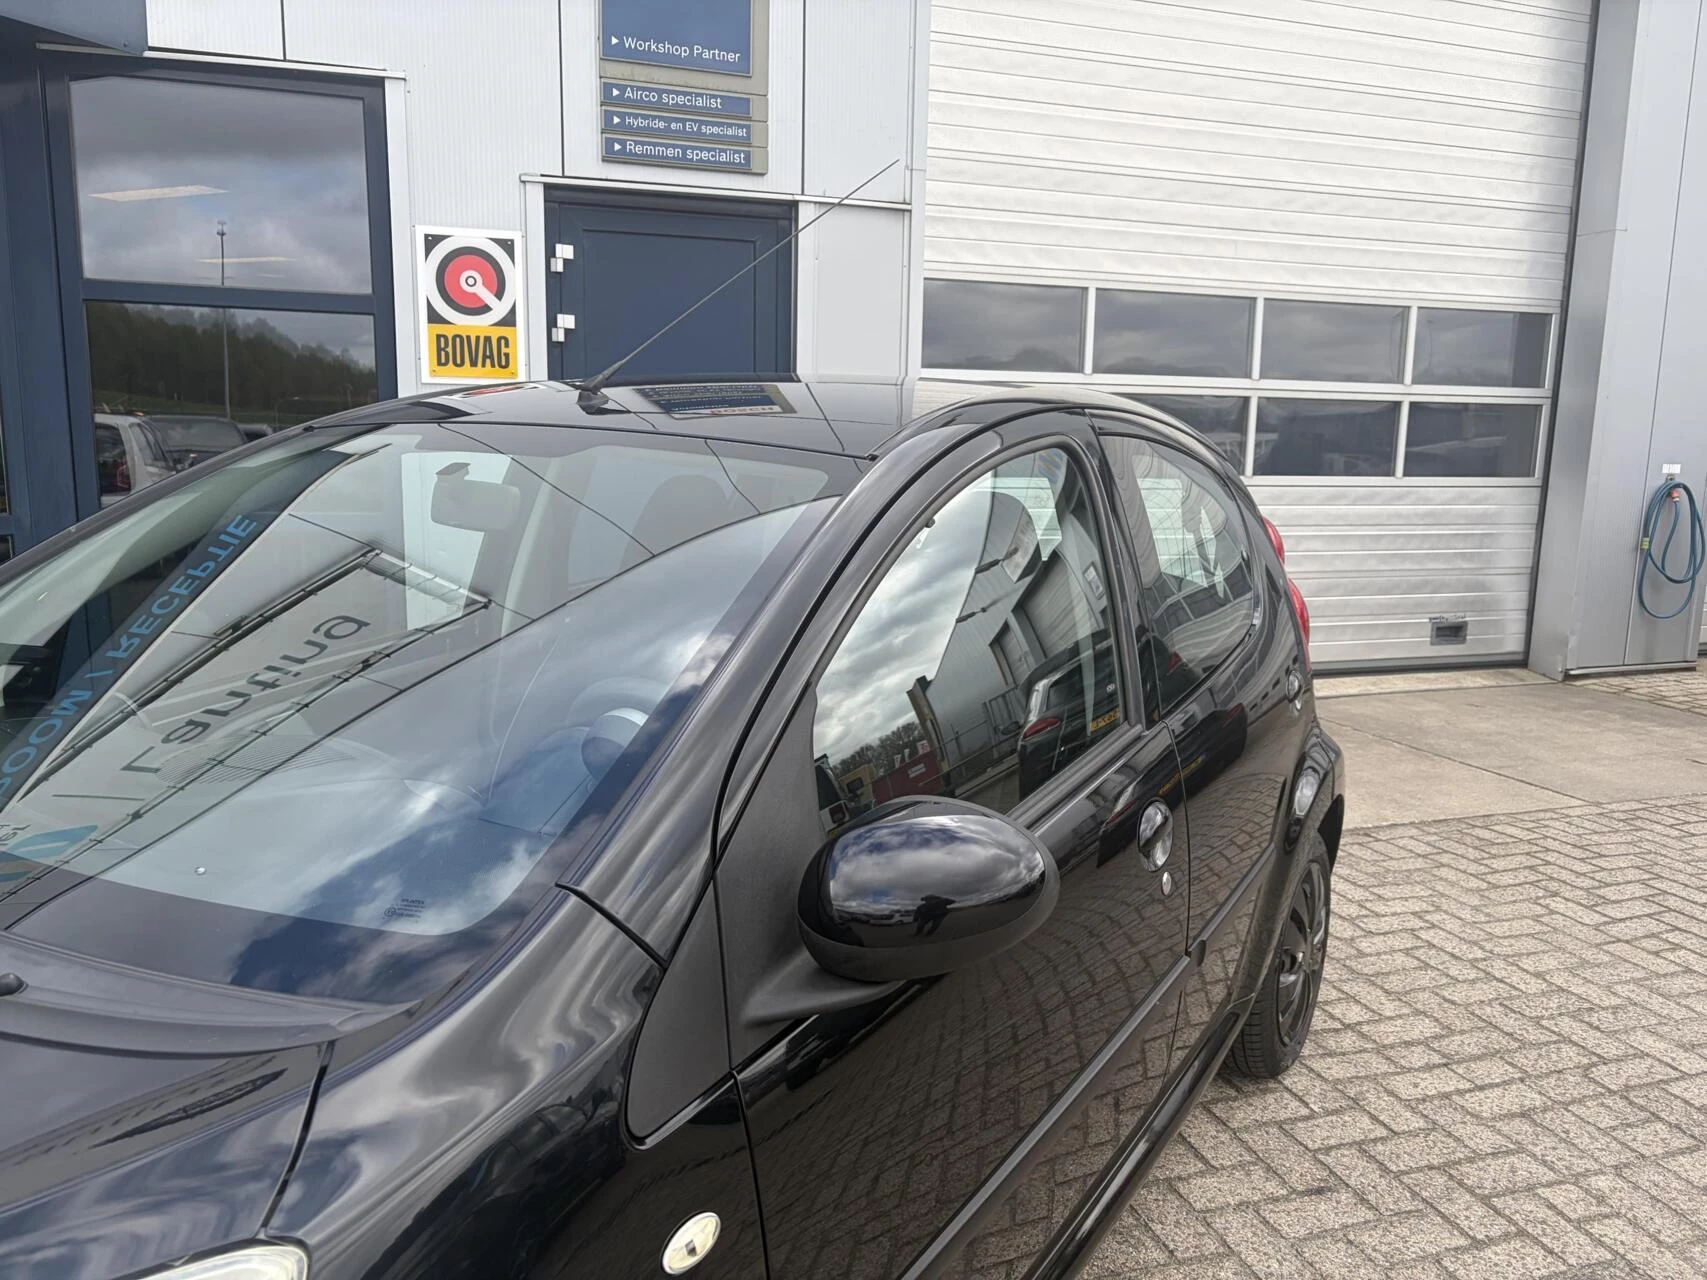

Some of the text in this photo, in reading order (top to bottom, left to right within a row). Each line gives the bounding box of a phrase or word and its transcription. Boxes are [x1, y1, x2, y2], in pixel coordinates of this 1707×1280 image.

[623, 35, 741, 63] Workshop Partner
[624, 87, 722, 109] Airco specialist
[625, 115, 748, 137] Hybride- en EV specialist
[626, 141, 745, 164] Remmen specialist
[435, 333, 510, 369] BOVAG
